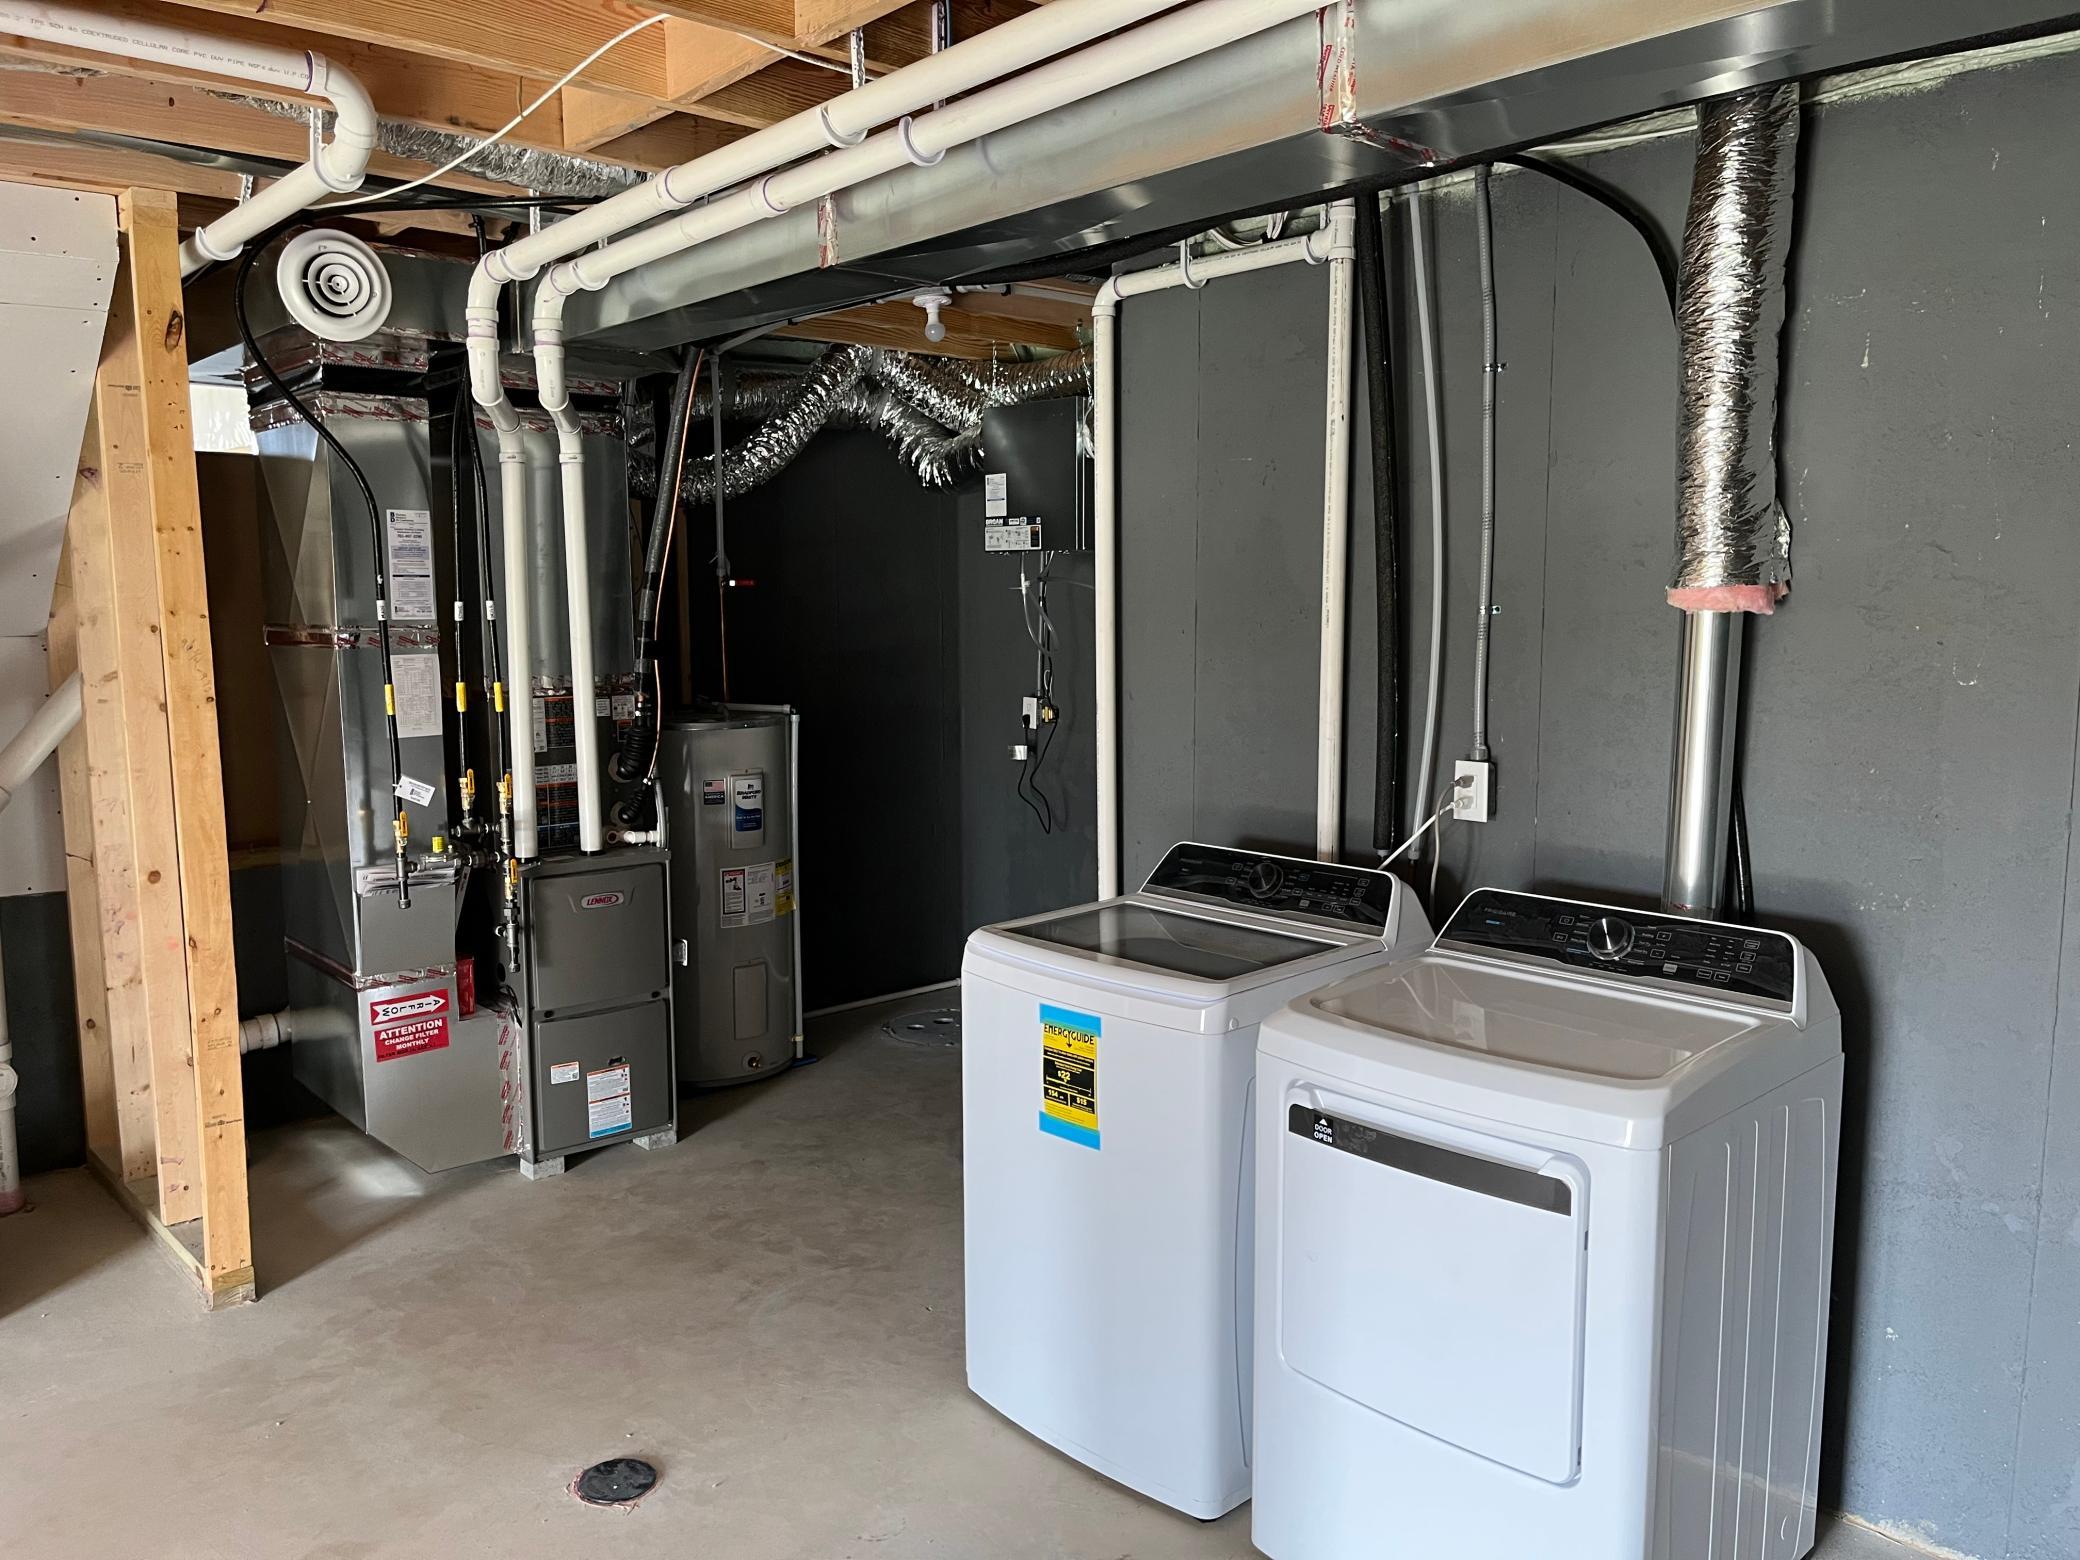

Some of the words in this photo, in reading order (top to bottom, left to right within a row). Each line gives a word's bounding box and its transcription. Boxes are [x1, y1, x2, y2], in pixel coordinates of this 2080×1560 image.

[81, 28, 129, 43] COEXTRUDED
[132, 37, 169, 51] CELLULAR
[172, 46, 190, 56] CORE
[194, 52, 207, 60] PVC
[227, 57, 245, 67] PIPE
[1336, 47, 1345, 64] COLD
[586, 896, 613, 906] LENNOX
[382, 999, 441, 1017] AIRFLOW
[379, 1019, 442, 1040] ATTENTION
[385, 1035, 414, 1046] CHANGE
[415, 1029, 439, 1039] FILTER
[396, 1038, 429, 1050] MONTHLY
[1314, 1131, 1333, 1144] OPEN
[1315, 1123, 1333, 1136] DOOR
